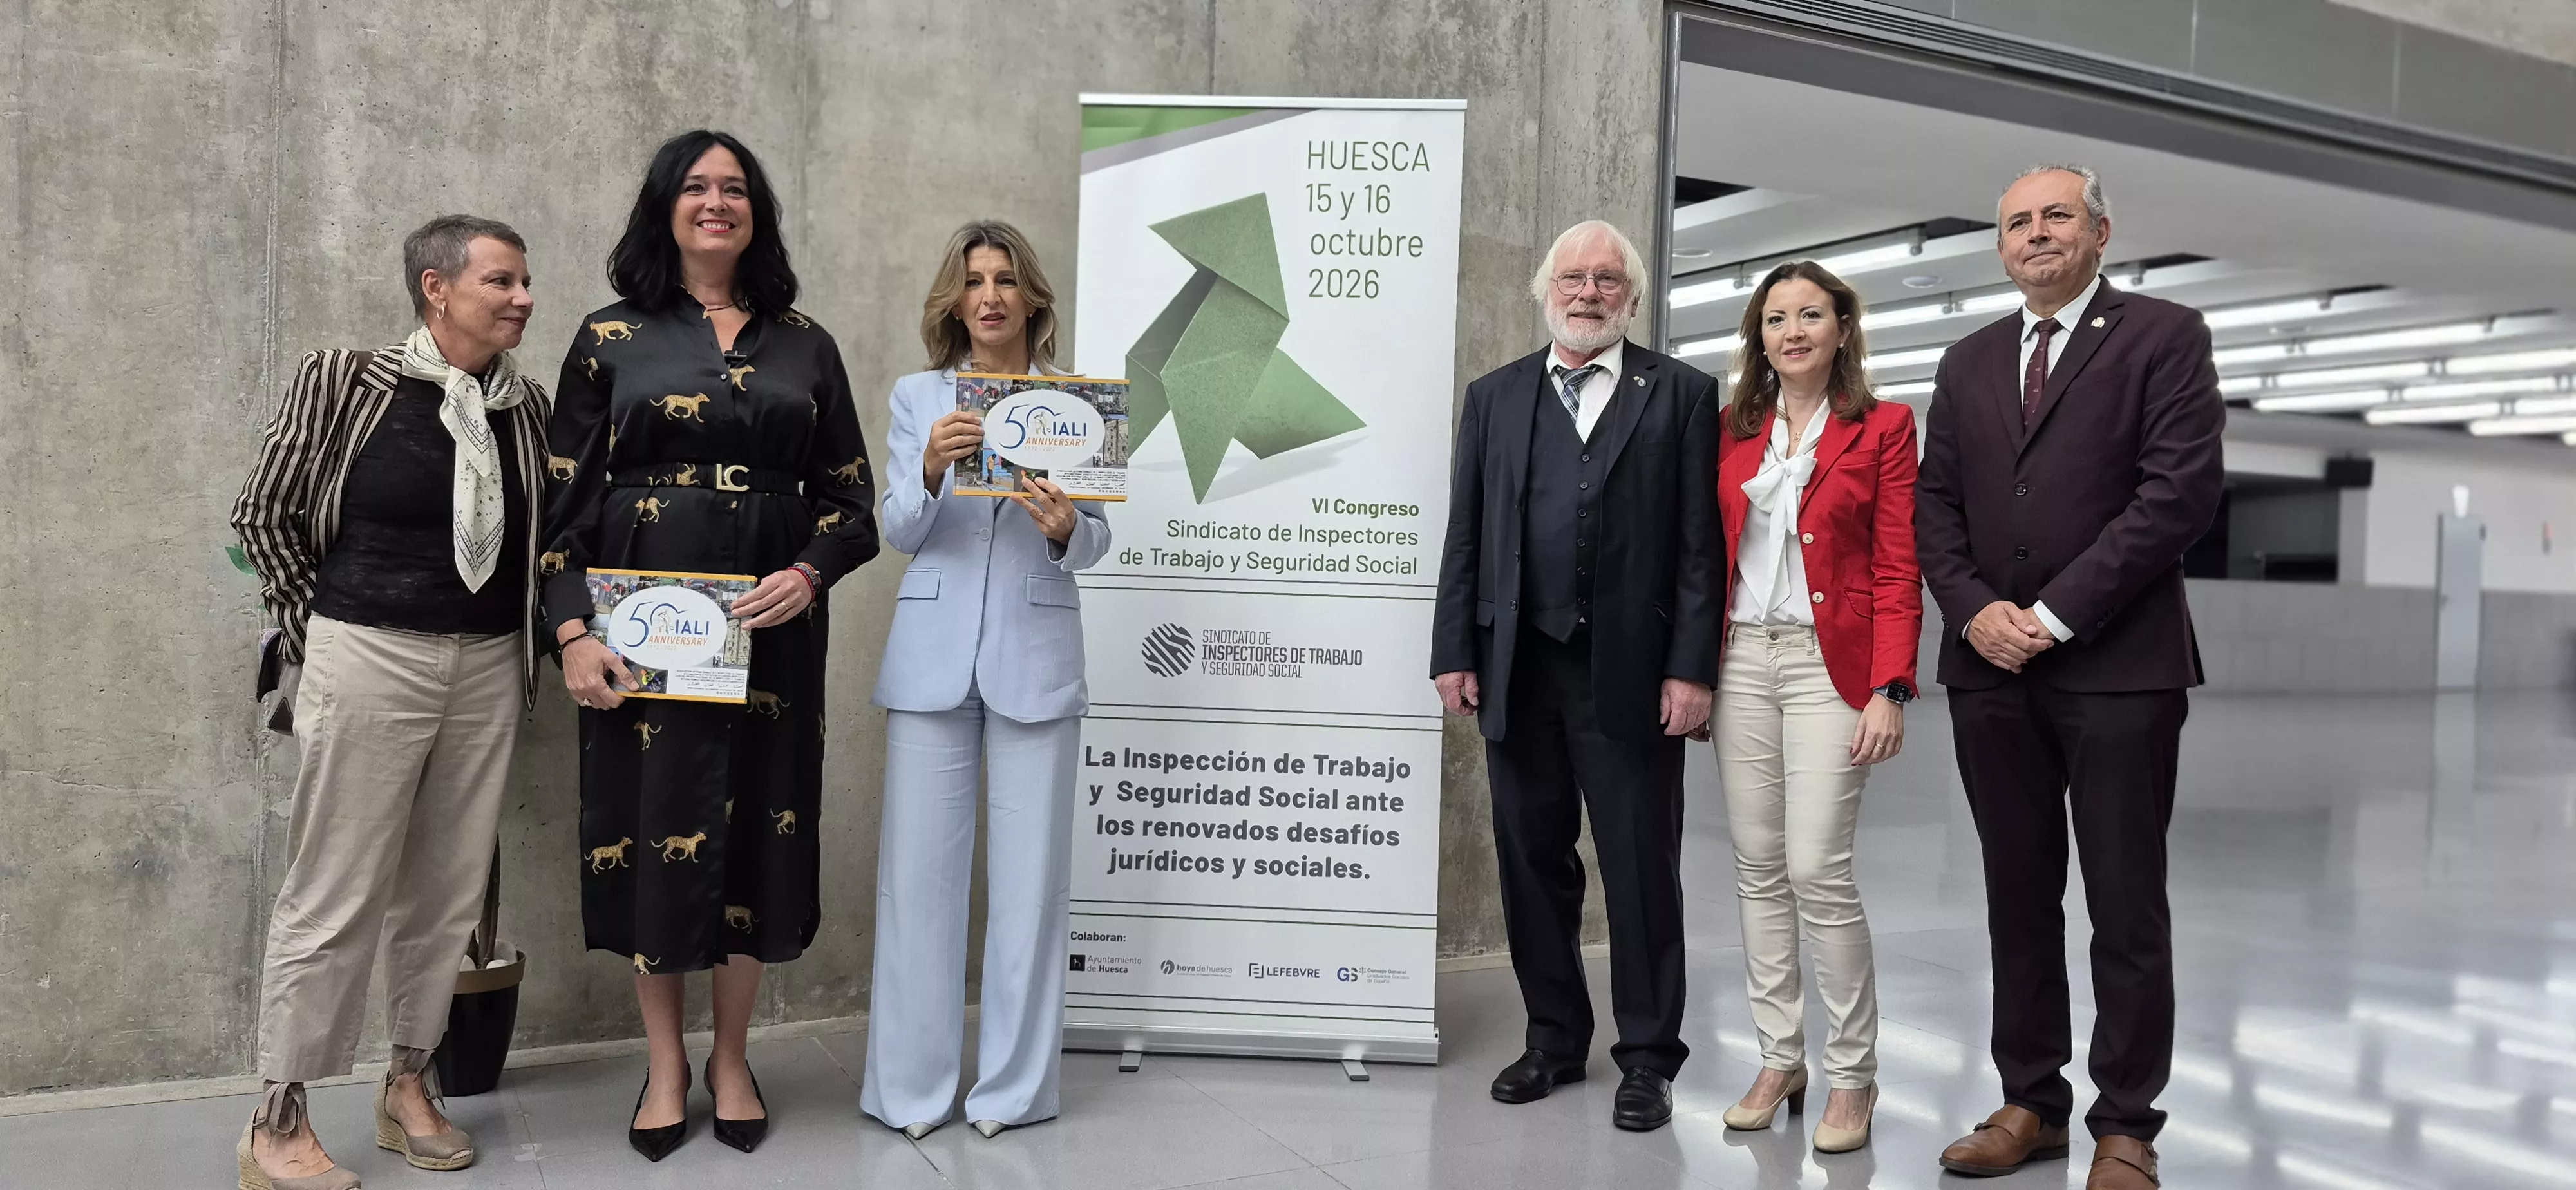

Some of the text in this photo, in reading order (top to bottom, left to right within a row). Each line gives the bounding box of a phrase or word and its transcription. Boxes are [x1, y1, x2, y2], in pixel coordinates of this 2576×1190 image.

[1308, 141, 1430, 171] HUESCA
[1306, 184, 1390, 220] 15 y 16
[1311, 227, 1423, 257] octubre
[1309, 269, 1378, 299] 2026
[1052, 422, 1087, 437] IALI
[1025, 437, 1086, 446] ANNIVERSARY
[716, 464, 750, 492] LC
[1312, 498, 1419, 518] VI Congreso
[1167, 520, 1417, 547] Sindicato de Inspectores
[1120, 547, 1416, 574] de Trabajo y Seguridad Social
[675, 619, 710, 636] IALI
[1203, 630, 1271, 645] SINDICATO DE
[648, 635, 709, 646] ANNIVERSARY
[1202, 645, 1362, 665] INSPECTORES DE TRABAJO
[1202, 662, 1302, 678] Y SEGURIDAD SOCIAL
[1086, 746, 1410, 783] La Inspección de Trabajo
[1089, 781, 1404, 812] y Seguridad Social ante
[1097, 814, 1399, 846] los renovados desafíos
[1107, 847, 1370, 879] jurídicos y sociales.
[1071, 931, 1126, 941] Colaboran:
[1088, 955, 1141, 964] Ayuntamiento
[1267, 967, 1320, 978] LEFEBVRE
[1337, 967, 1358, 982] GS
